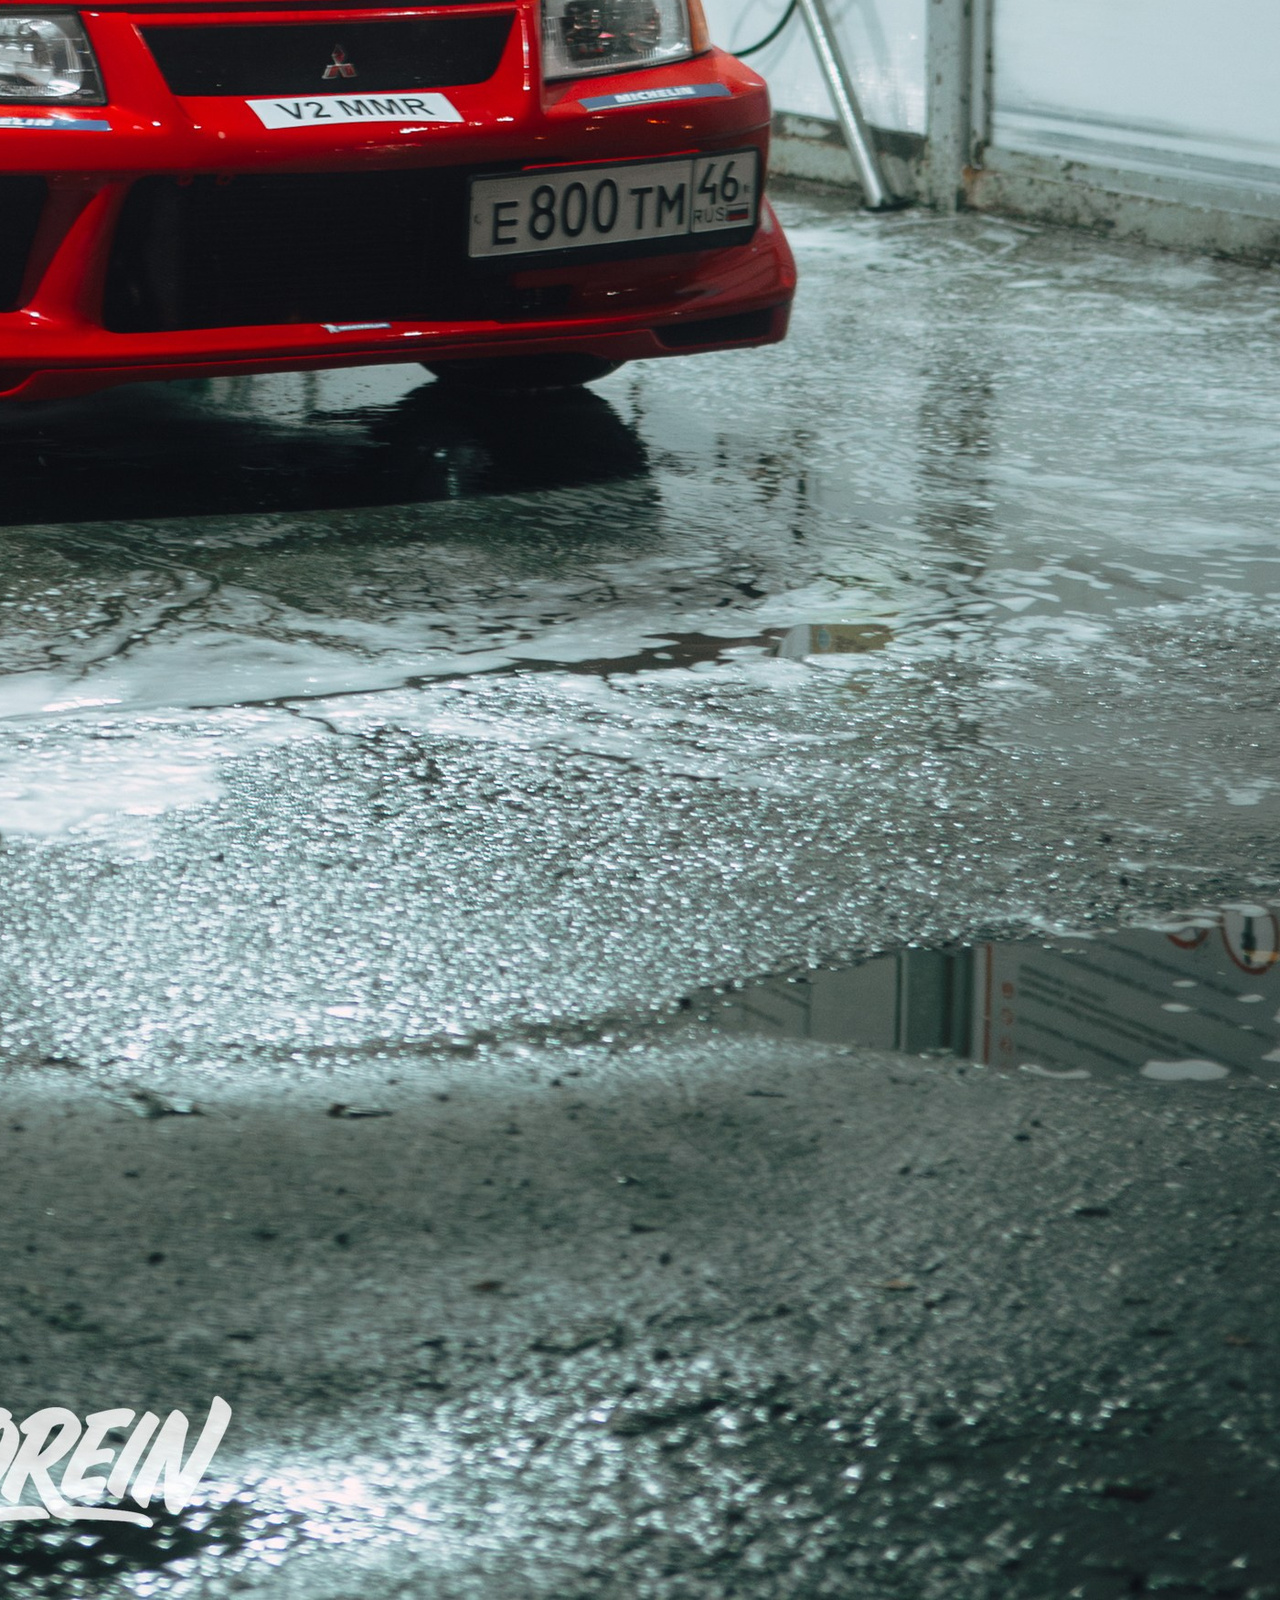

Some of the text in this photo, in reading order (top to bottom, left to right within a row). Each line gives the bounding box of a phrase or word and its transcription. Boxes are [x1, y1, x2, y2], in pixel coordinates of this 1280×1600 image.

[614, 86, 696, 103] MICHELIN
[275, 97, 436, 120] V2 MMR
[698, 160, 739, 205] 46
[693, 206, 725, 224] RUS
